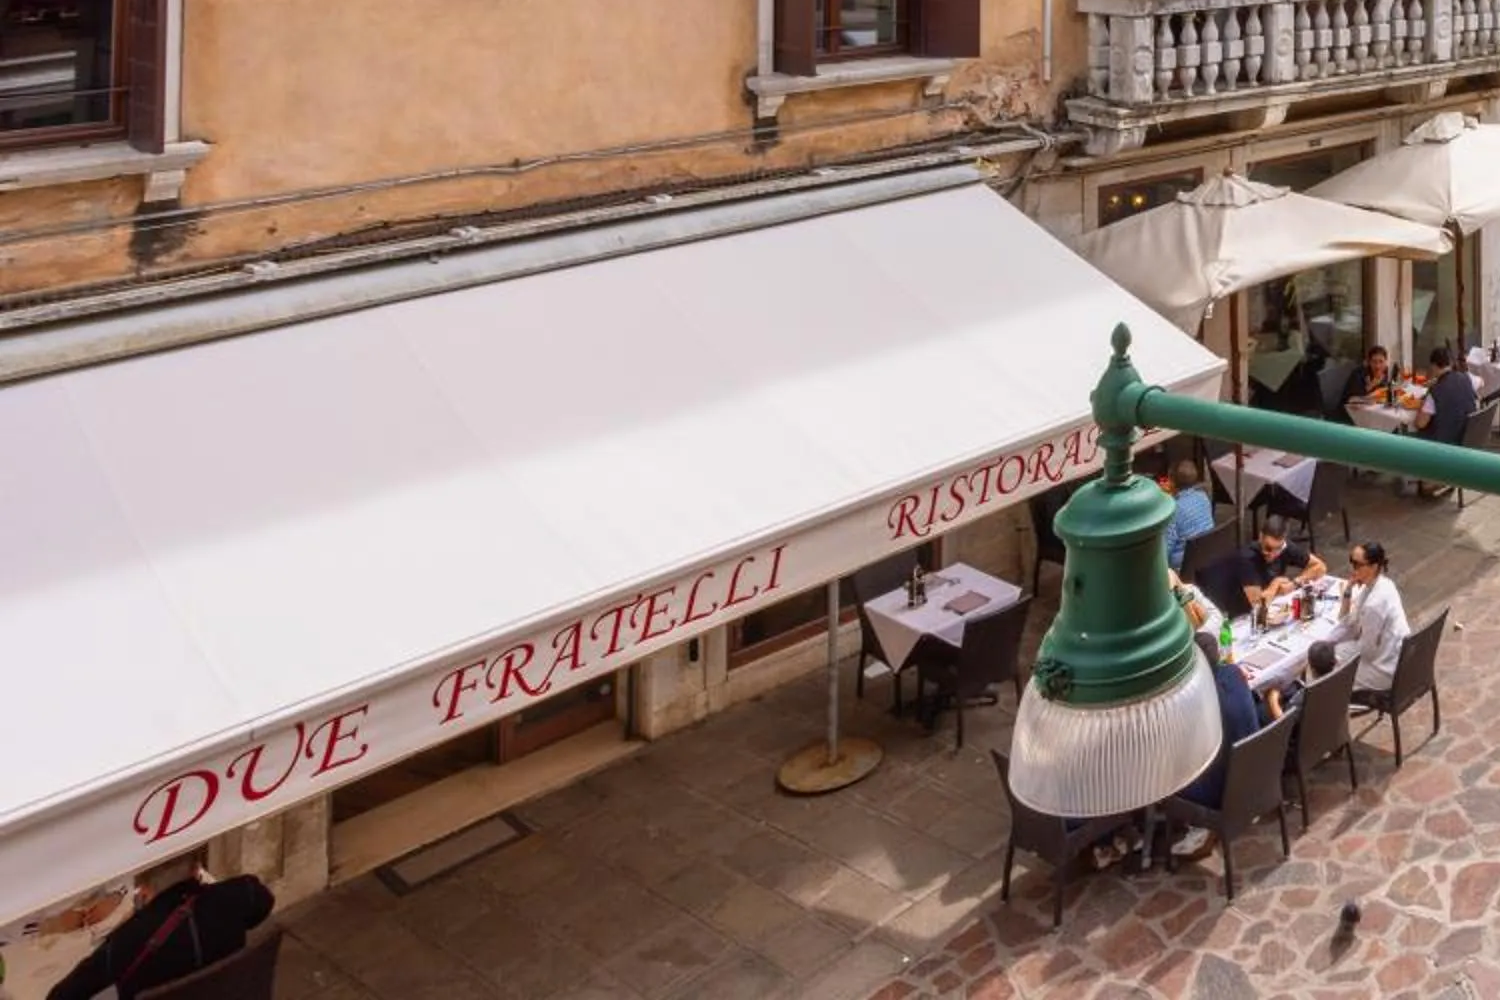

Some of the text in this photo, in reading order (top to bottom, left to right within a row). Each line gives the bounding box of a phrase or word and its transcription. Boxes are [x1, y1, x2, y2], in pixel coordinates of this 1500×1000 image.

[132, 423, 1160, 845] DUE FRATELLI RISTORA
